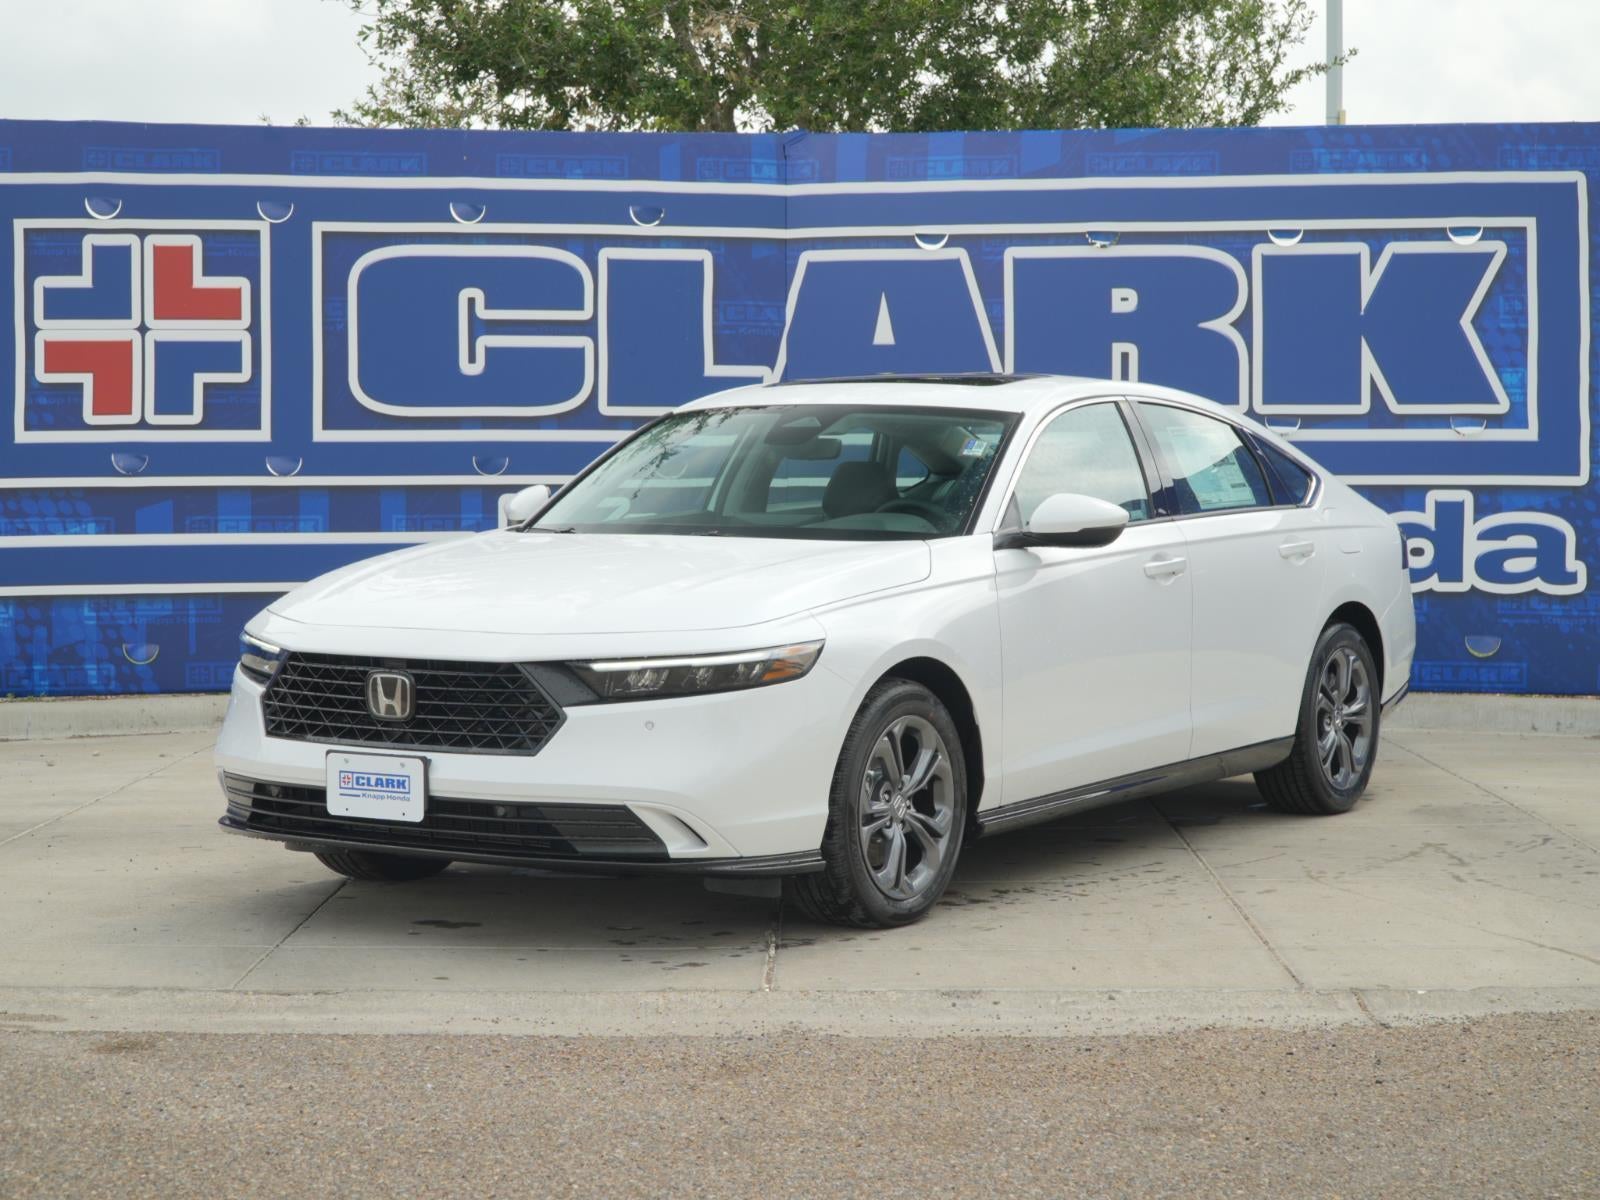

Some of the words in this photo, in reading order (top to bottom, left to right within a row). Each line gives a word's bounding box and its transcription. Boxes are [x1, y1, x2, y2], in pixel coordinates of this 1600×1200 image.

[347, 240, 1510, 417] CLARK
[354, 775, 407, 790] CLARK
[361, 793, 386, 801] Knapp
